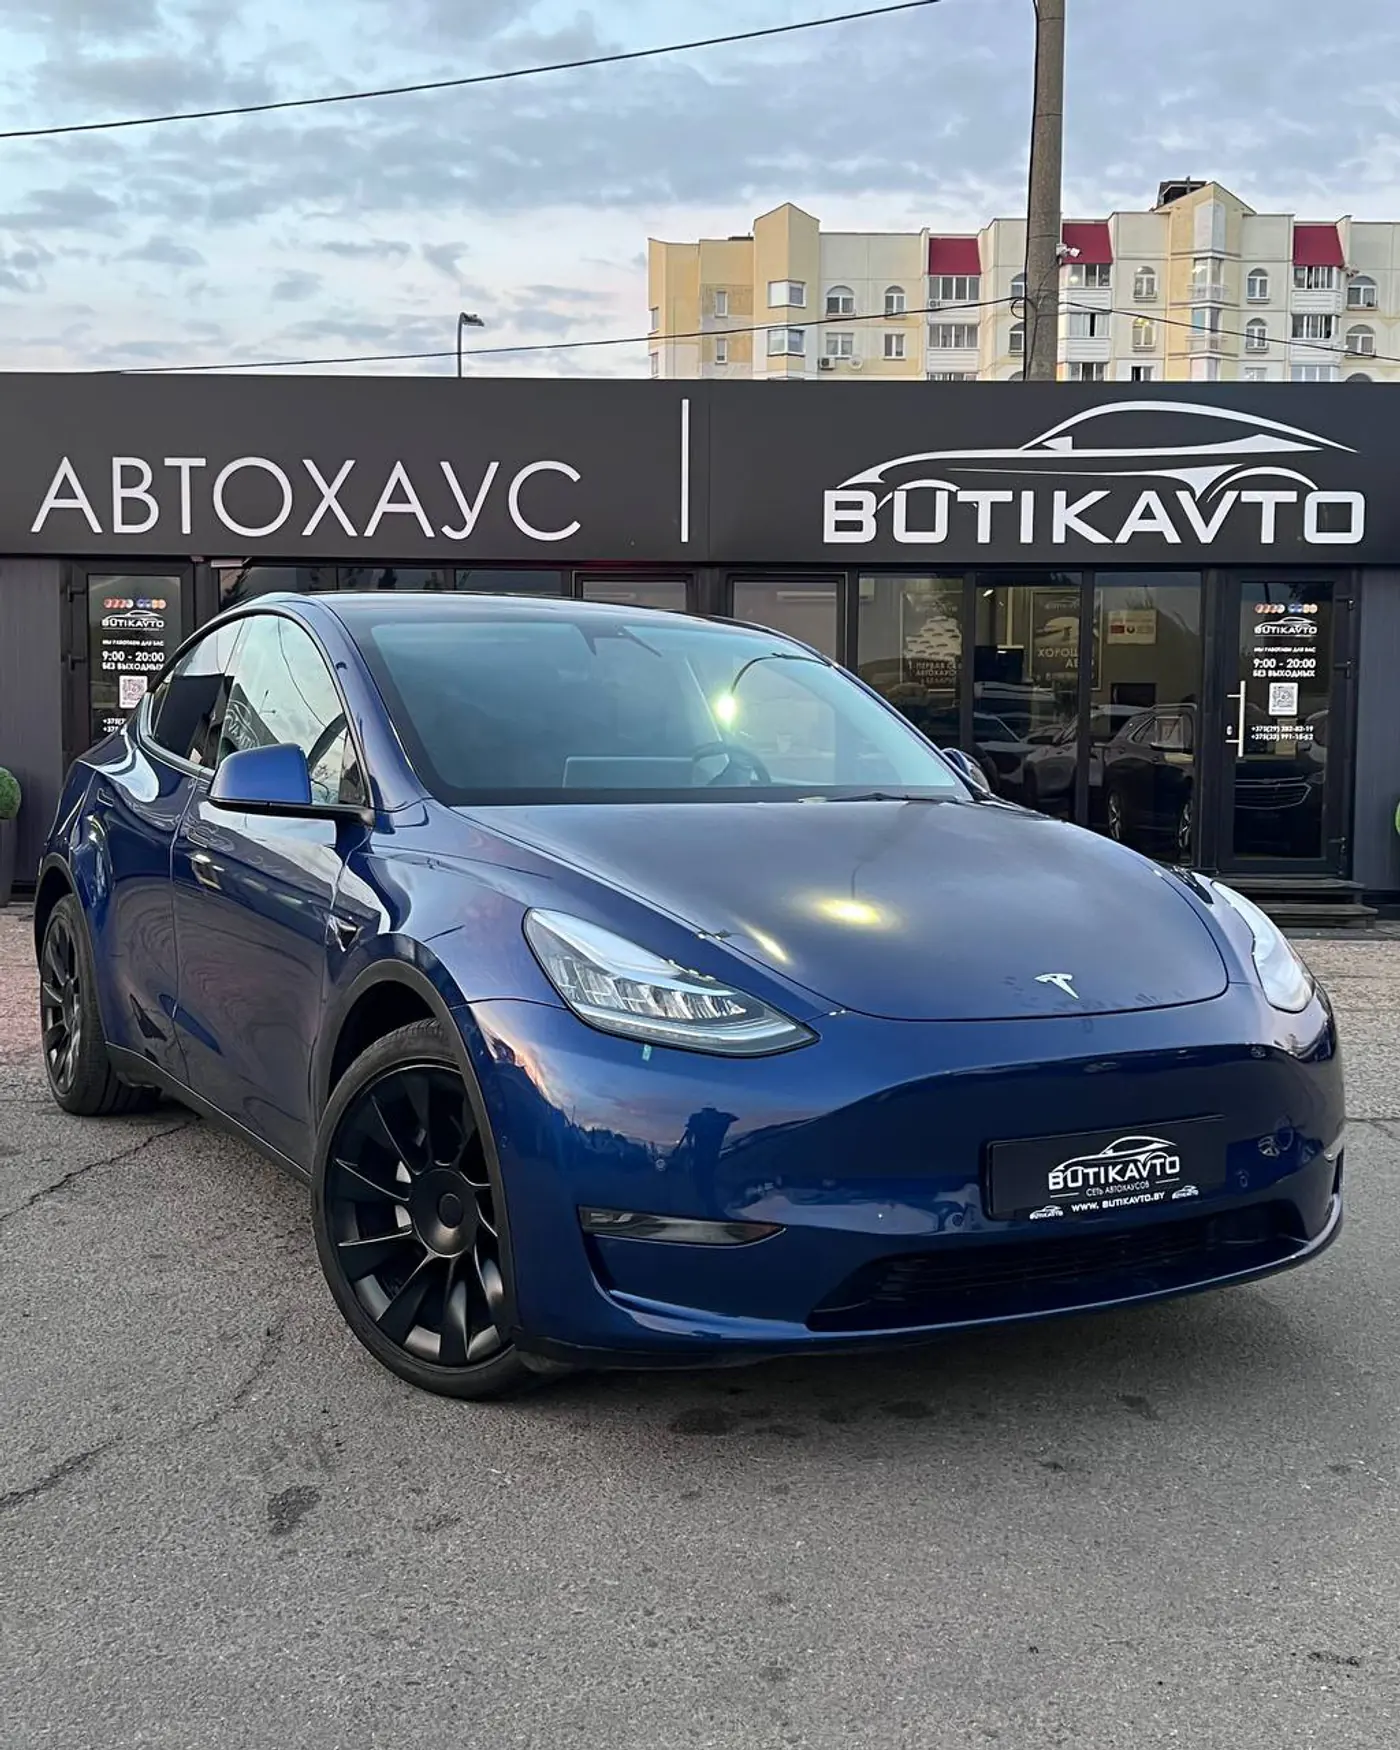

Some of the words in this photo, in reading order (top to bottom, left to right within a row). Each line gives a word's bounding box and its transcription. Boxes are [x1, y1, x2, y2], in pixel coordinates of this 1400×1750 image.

[31, 457, 580, 540] АВТОХАУС
[823, 490, 1365, 544] BUTIKAVTO
[102, 619, 164, 628] BUTIKAVTO
[1254, 625, 1317, 634] BUTIKAVTO
[102, 651, 125, 662] 9:00
[135, 652, 165, 662] 20:00
[102, 662, 115, 670] БЕЗ
[1253, 658, 1277, 669] 9:00
[1286, 658, 1316, 669] 20:00
[1253, 669, 1266, 678] БЕЗ
[1268, 669, 1315, 678] ВЫХОДНЫХ
[1048, 1156, 1180, 1190] BUTIKAVTO
[1086, 1187, 1105, 1197] СЕТЬ
[1105, 1180, 1150, 1194] АВТОХАУСОВ
